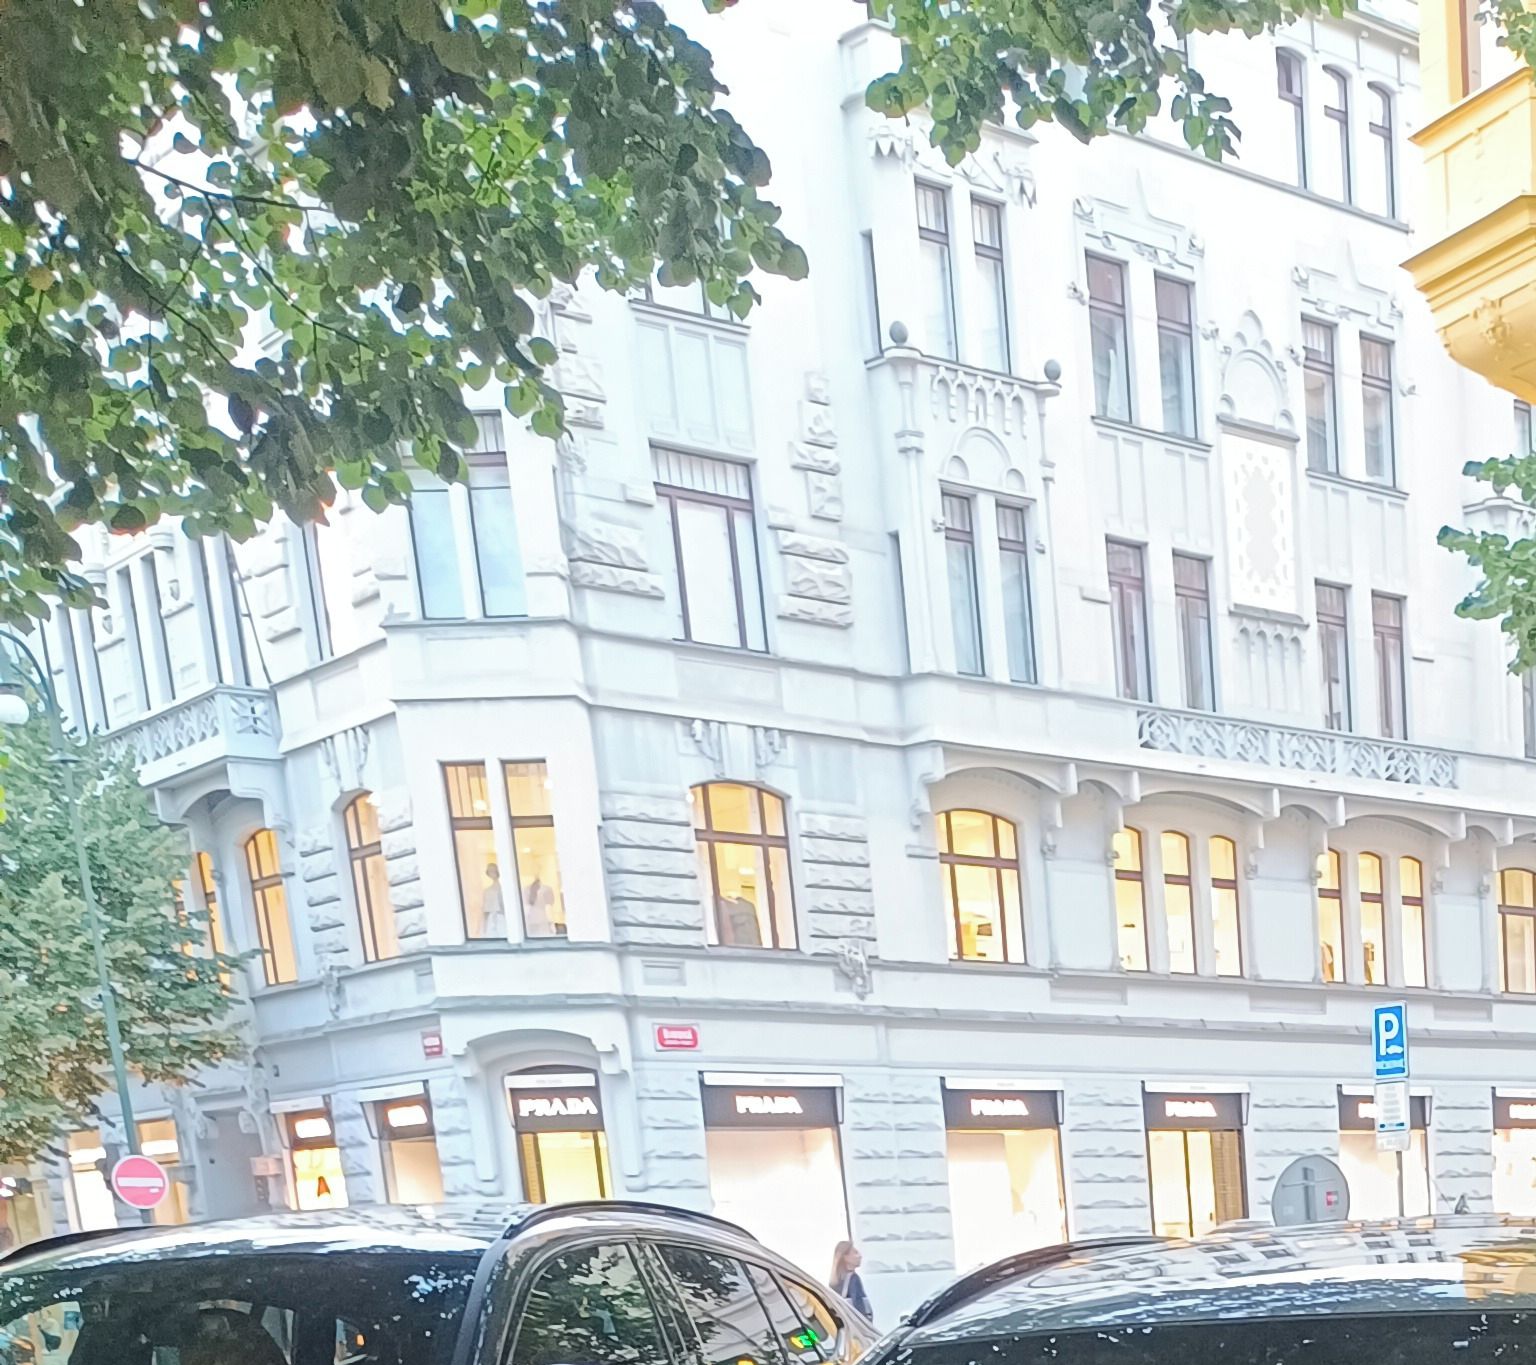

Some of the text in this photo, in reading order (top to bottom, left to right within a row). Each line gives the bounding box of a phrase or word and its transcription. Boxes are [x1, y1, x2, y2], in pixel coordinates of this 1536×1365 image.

[1378, 1012, 1400, 1056] P
[519, 1096, 598, 1117] PRADA
[735, 1095, 803, 1114] PRADA
